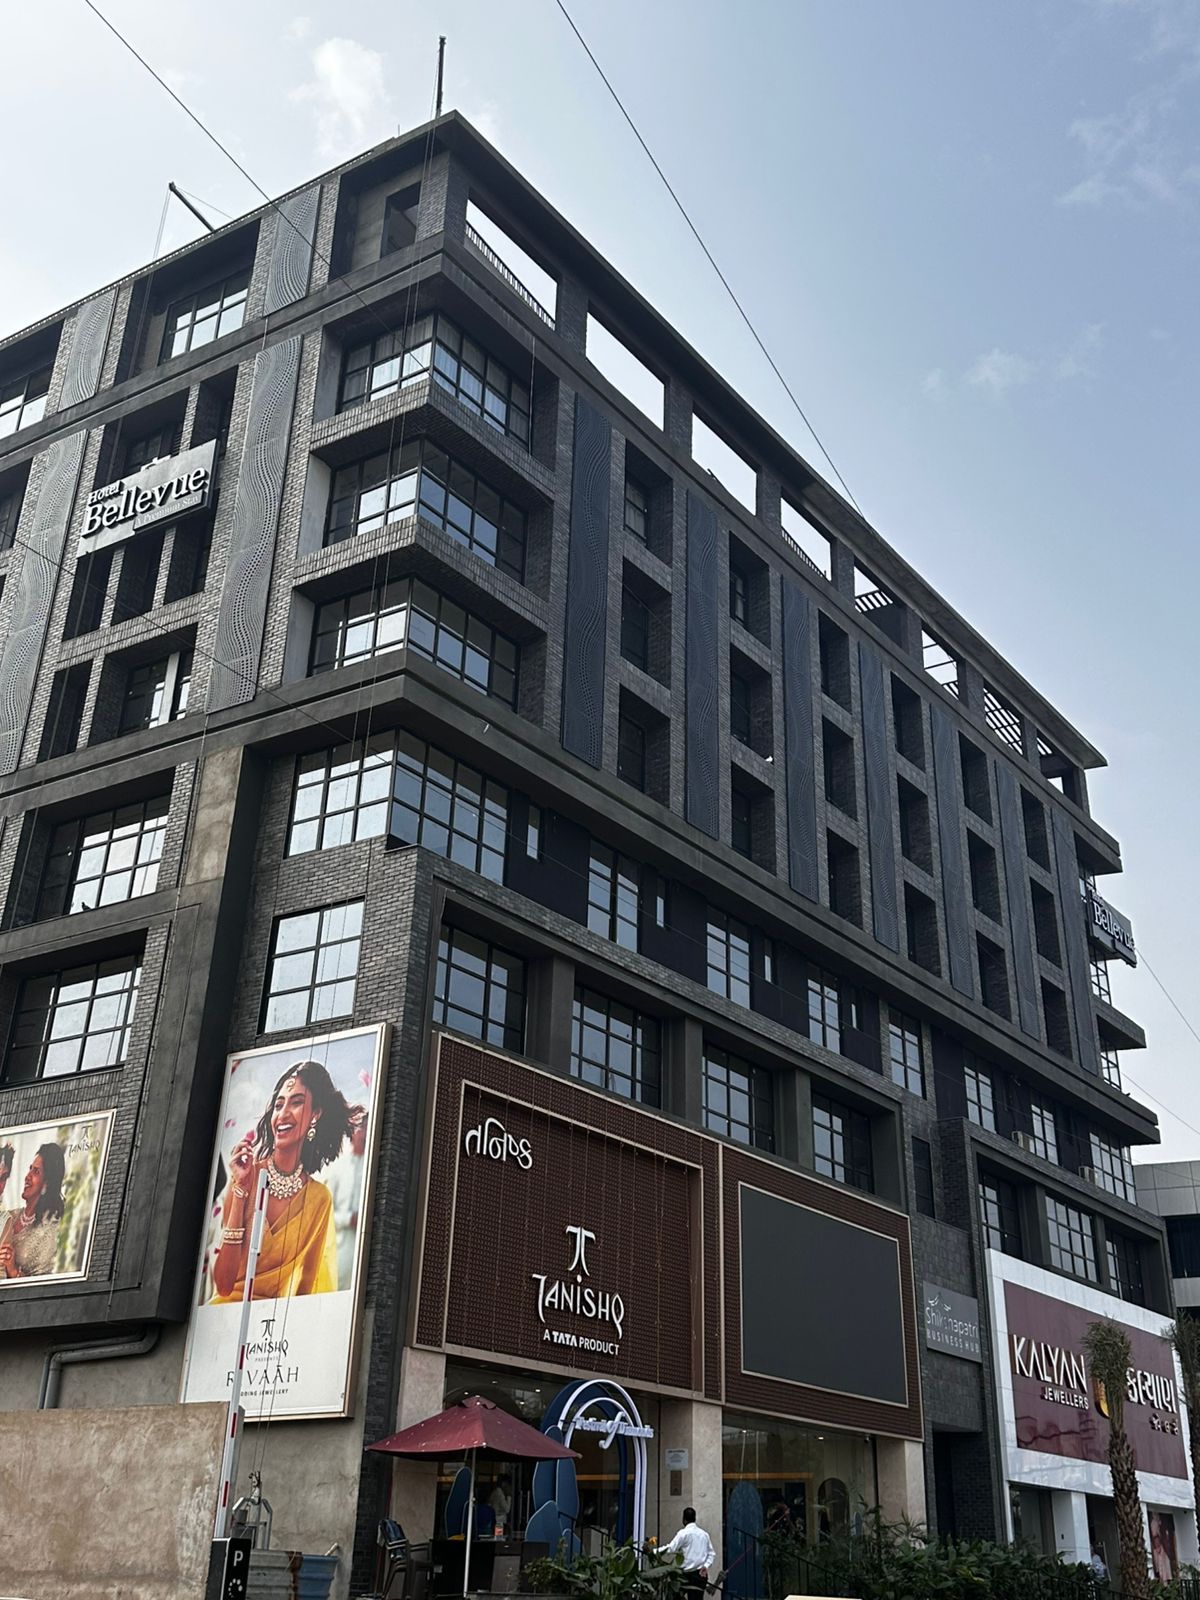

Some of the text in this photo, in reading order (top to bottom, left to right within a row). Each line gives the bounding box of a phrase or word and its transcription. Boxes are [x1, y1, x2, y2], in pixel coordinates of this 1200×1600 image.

[82, 467, 206, 537] Bellevue
[88, 480, 121, 503] Hotel
[543, 1329, 620, 1356] A TATA PRODUCT
[1012, 1334, 1088, 1393] KALYAN
[1043, 1387, 1089, 1410] JEWELLERS
[233, 1550, 244, 1567] P
